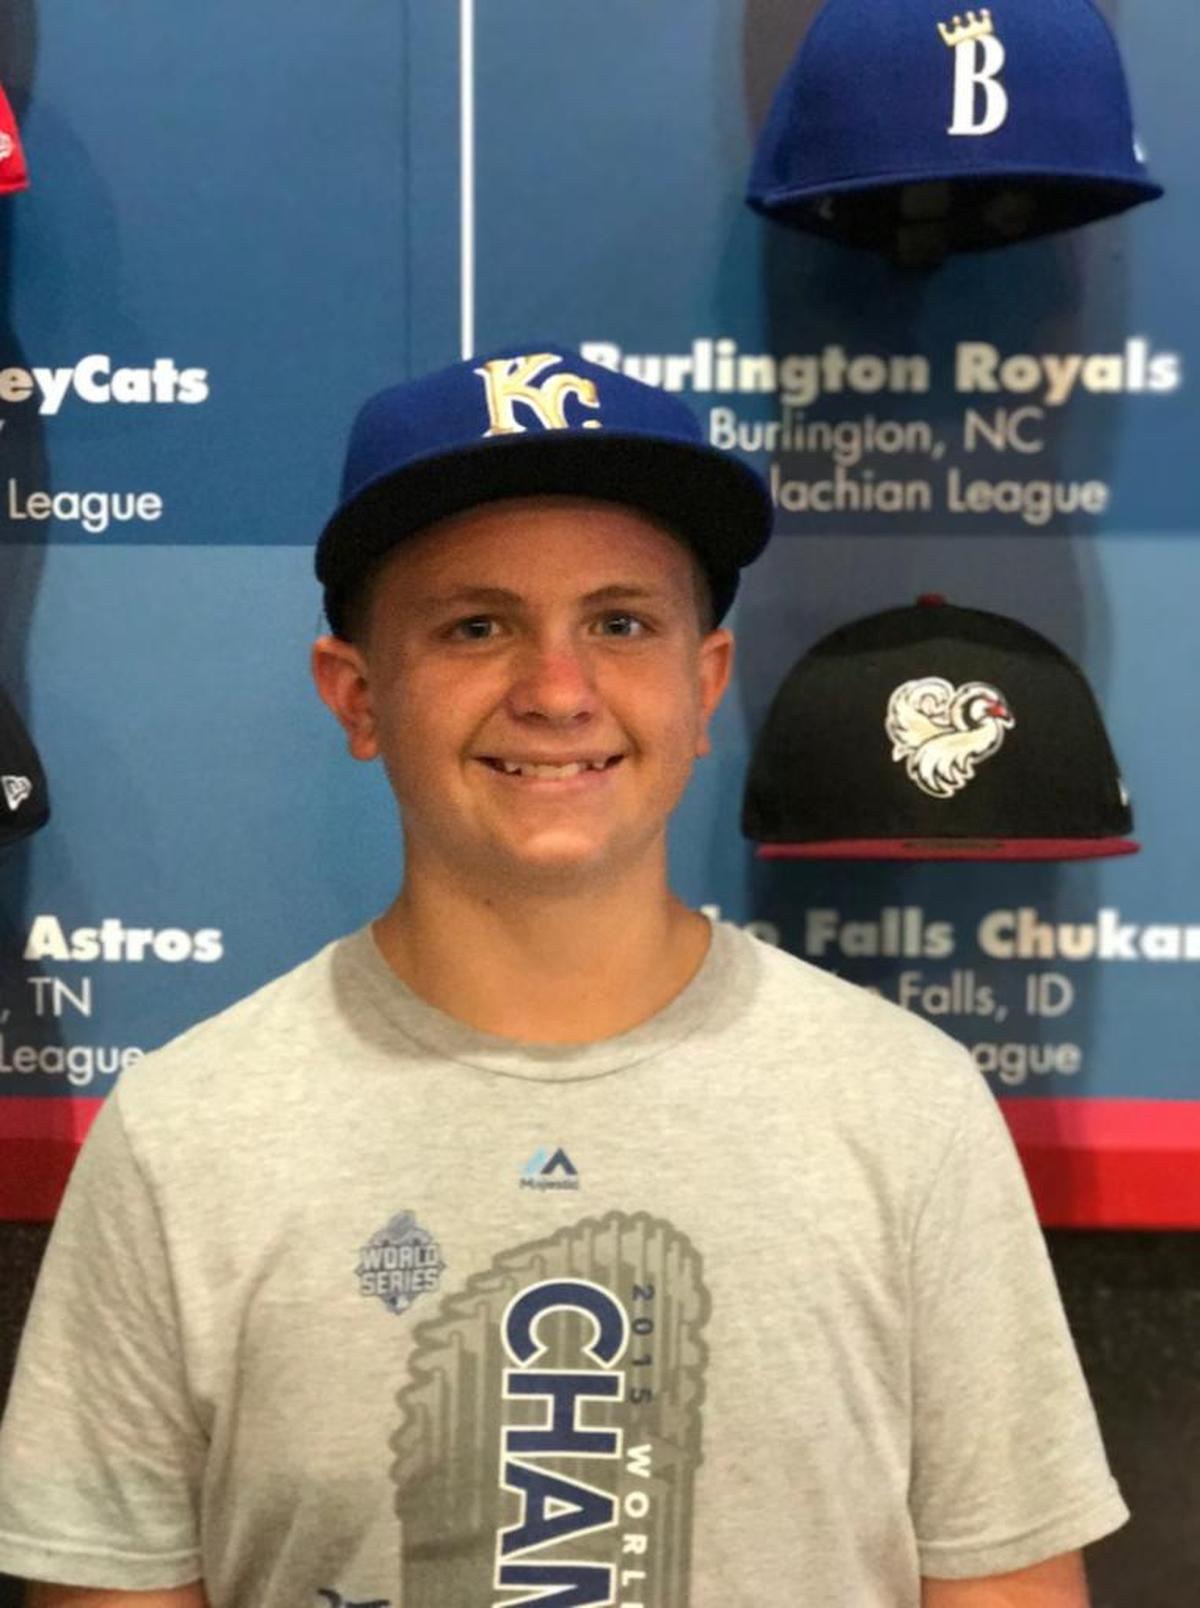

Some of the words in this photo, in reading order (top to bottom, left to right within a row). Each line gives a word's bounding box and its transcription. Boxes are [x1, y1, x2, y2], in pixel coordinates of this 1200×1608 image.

[947, 33, 1008, 136] B
[0, 354, 209, 415] eyCats
[473, 352, 602, 437] KC
[956, 338, 1180, 405] Royals
[709, 405, 946, 465] Burlington,
[963, 406, 1044, 452] NC
[8, 478, 163, 533] League
[948, 468, 1109, 526] League
[23, 915, 224, 963] Astros
[805, 907, 956, 958] Falls
[27, 977, 91, 1017] TN
[900, 970, 1009, 1023] Falls,
[1026, 972, 1074, 1018] ID
[359, 1267, 440, 1296] SERIES
[360, 1244, 440, 1270] WORLD
[630, 1284, 655, 1405] 2015
[618, 1444, 653, 1608] WORL
